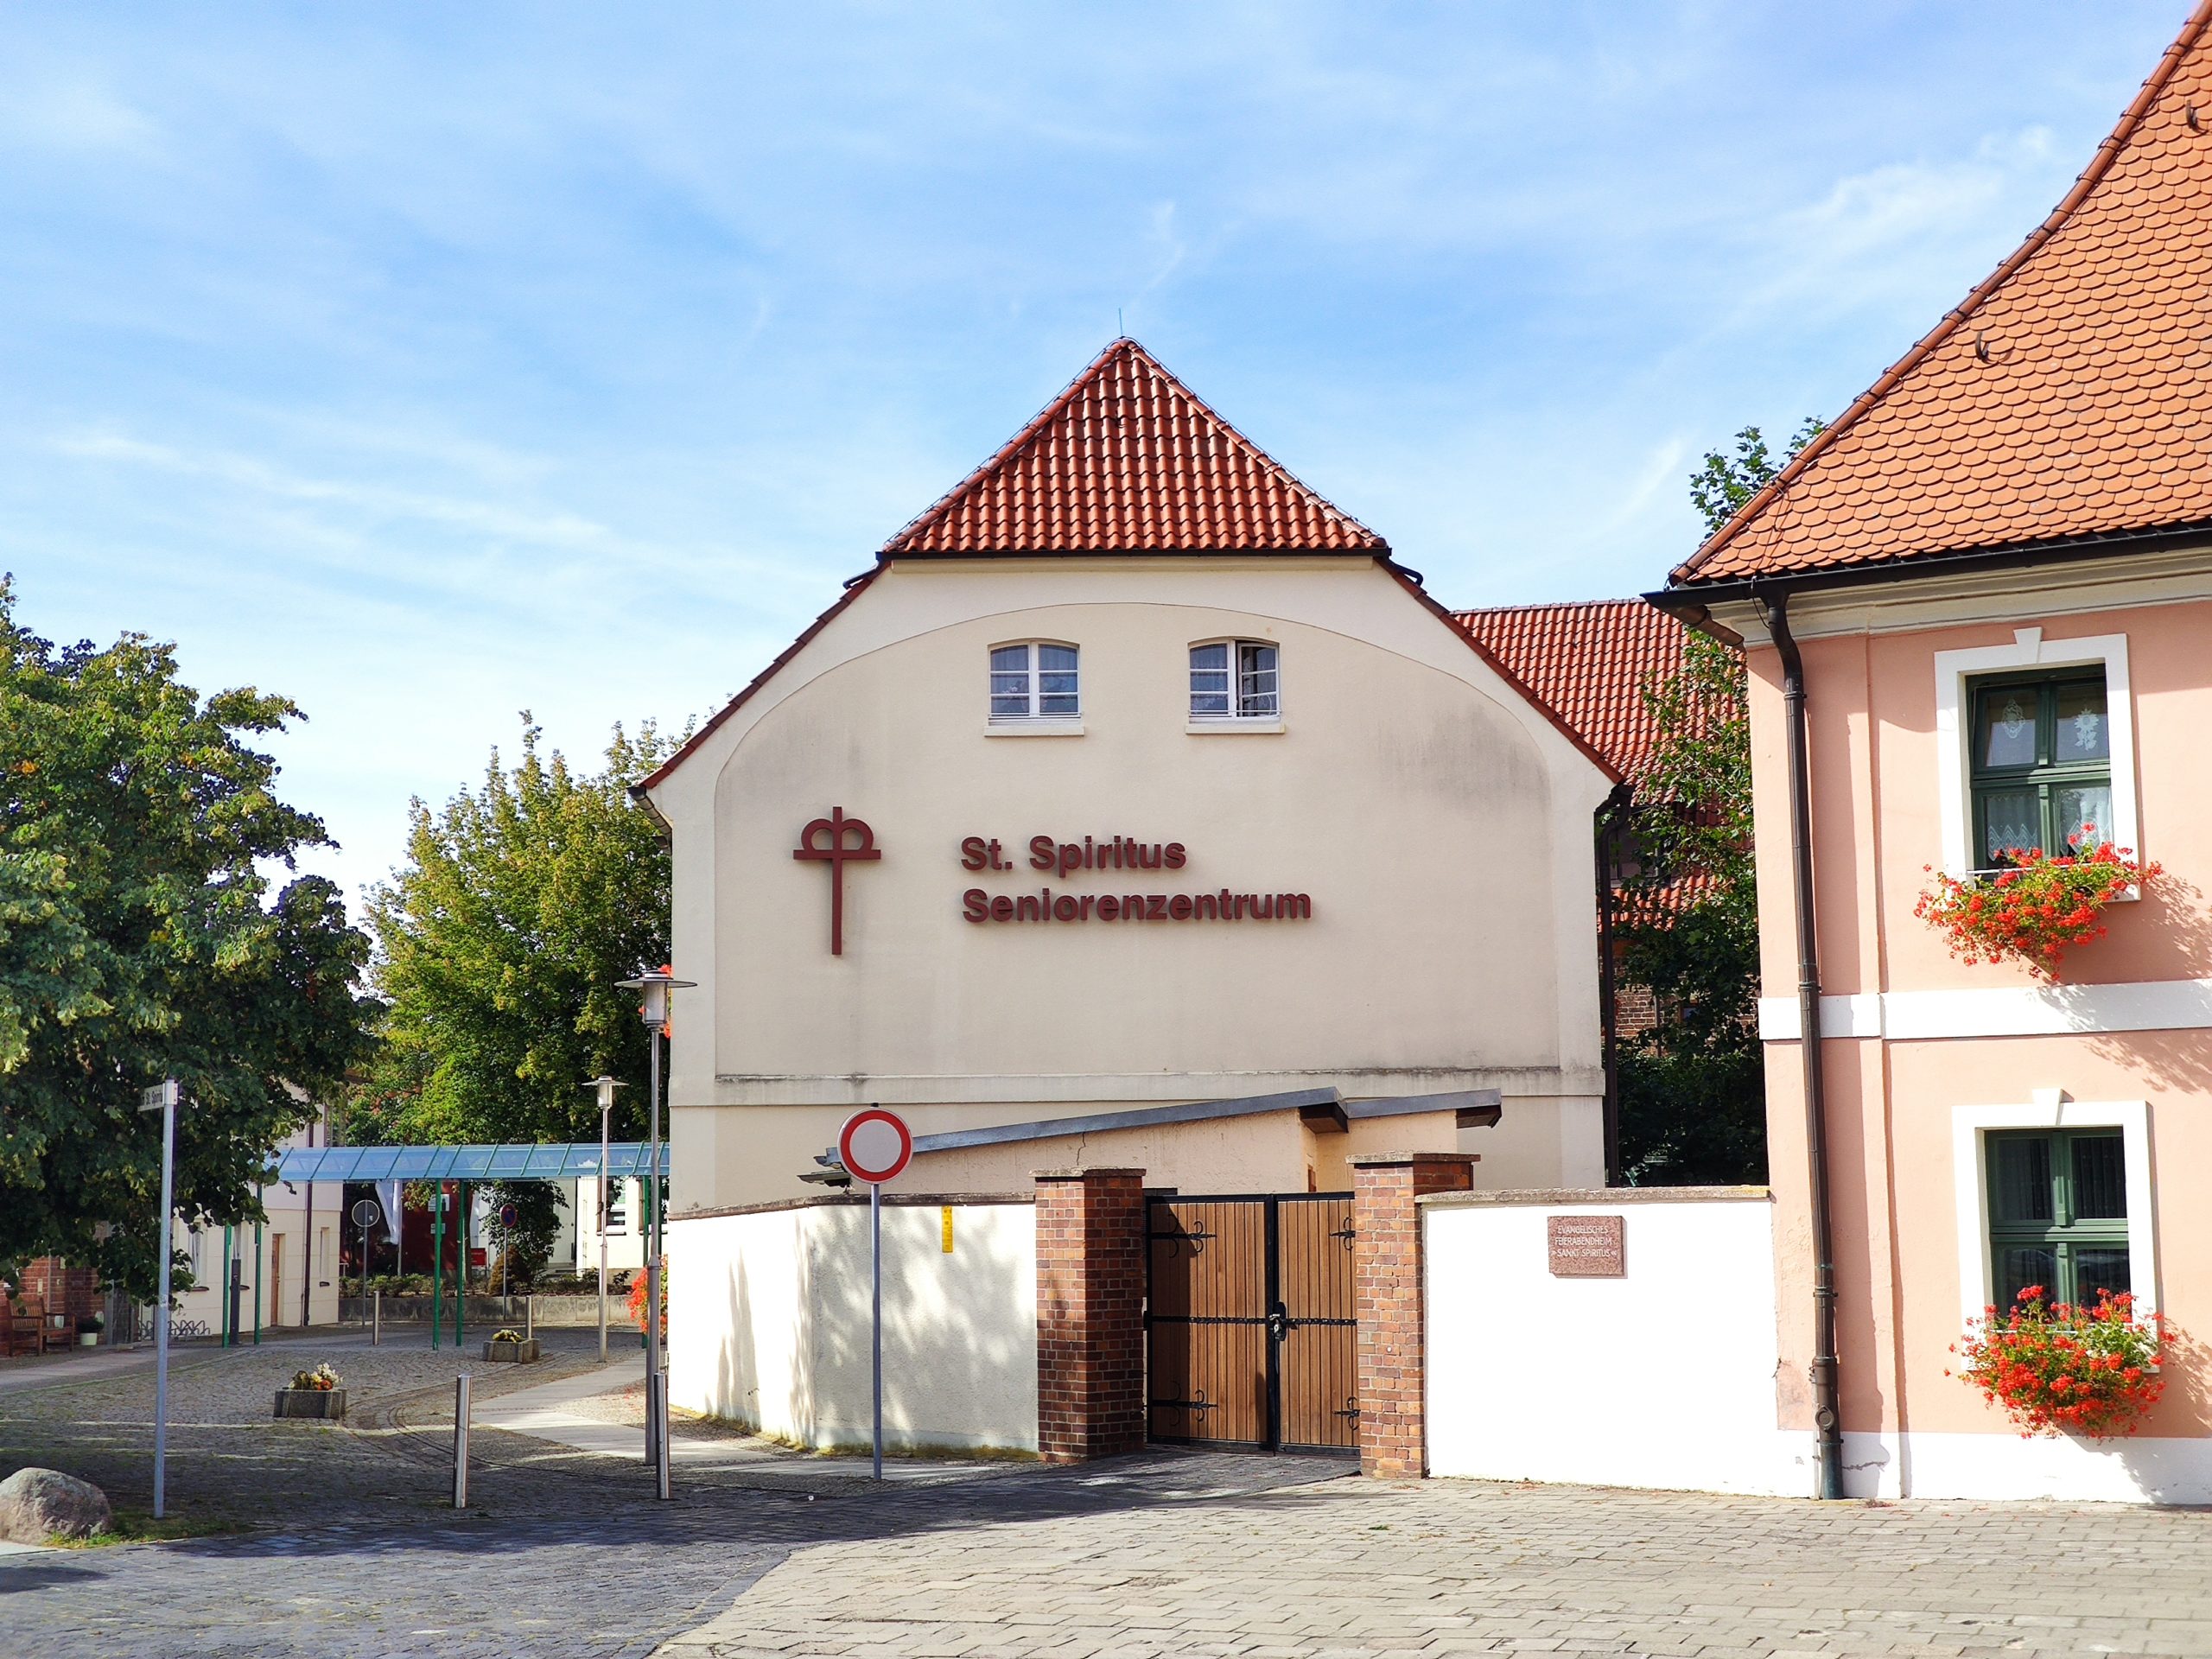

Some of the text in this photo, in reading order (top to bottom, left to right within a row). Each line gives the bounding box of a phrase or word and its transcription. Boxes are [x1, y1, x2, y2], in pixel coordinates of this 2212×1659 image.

[961, 835, 1186, 878] St. Spiritus
[963, 887, 1312, 923] Seniorenzentrum
[1555, 1236, 1612, 1245] FEIERABENDHEIM
[1557, 1225, 1609, 1234] EVANGELISCHES
